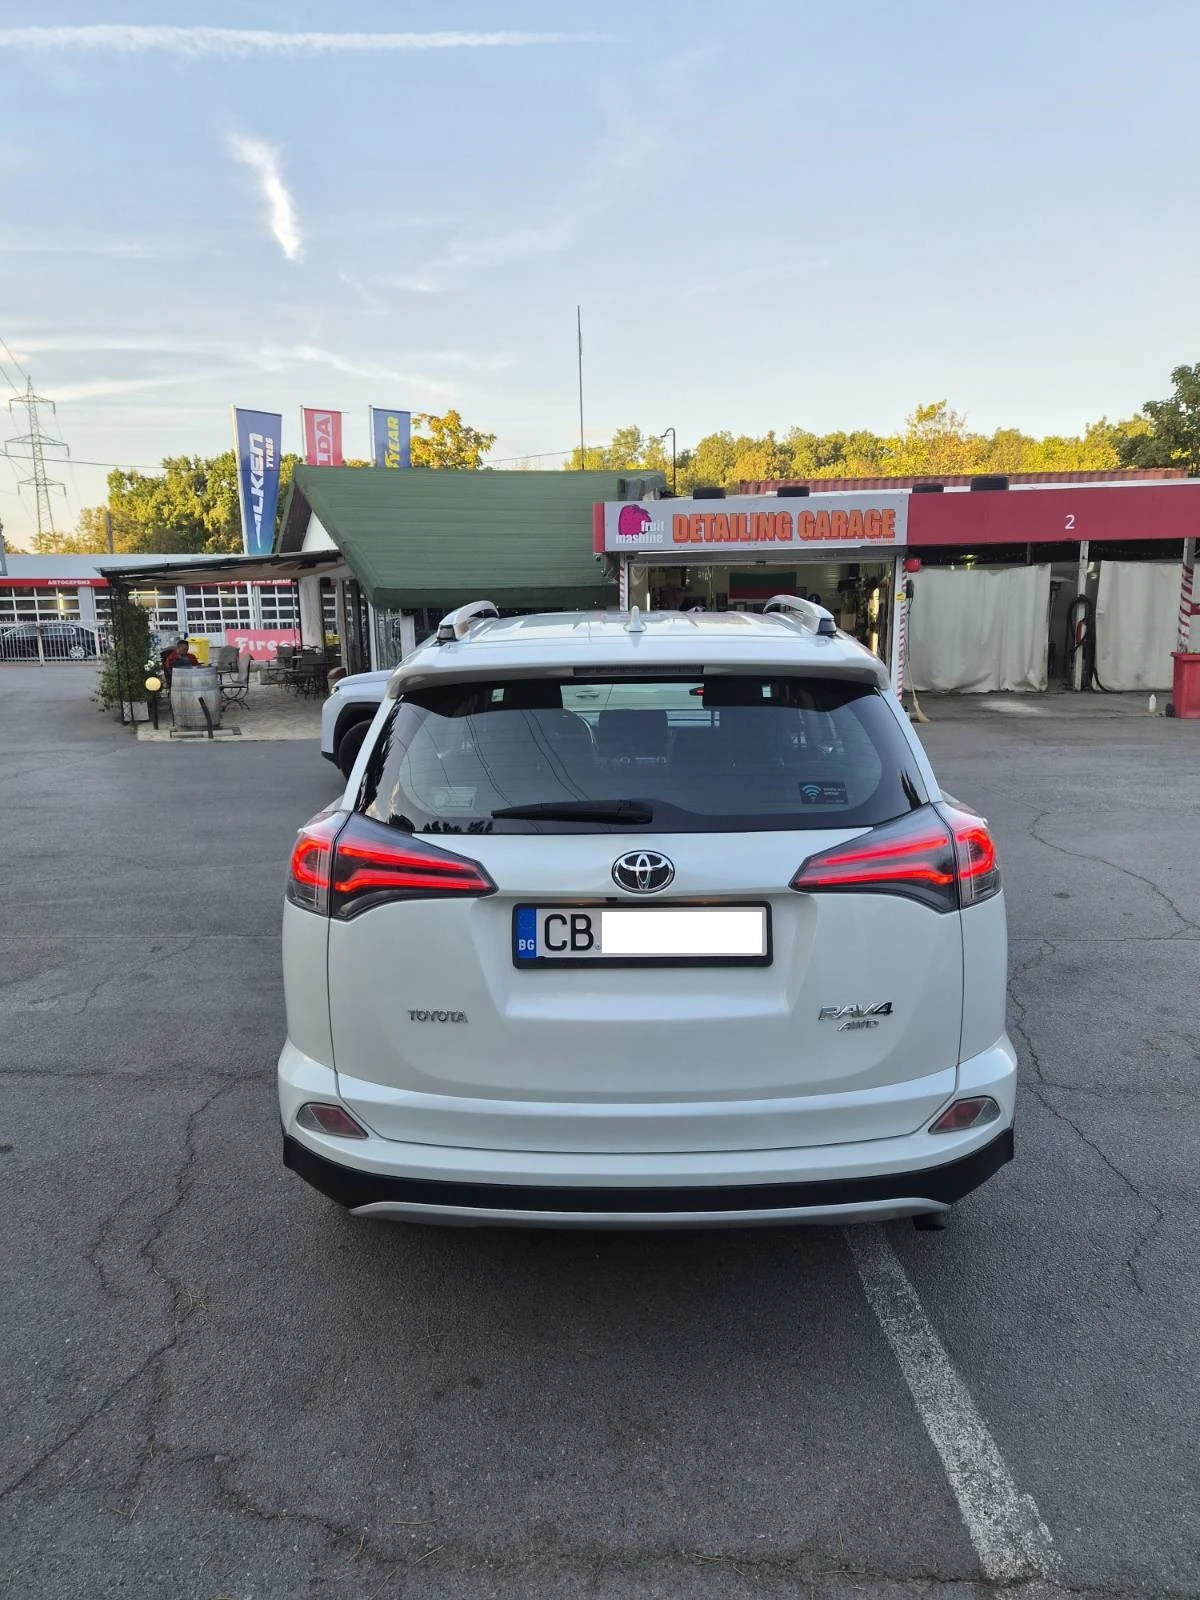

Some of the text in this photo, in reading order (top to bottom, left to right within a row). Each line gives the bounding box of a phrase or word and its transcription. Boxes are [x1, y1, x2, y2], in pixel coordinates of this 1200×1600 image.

[641, 520, 664, 532] fruit
[672, 509, 896, 543] DETAILING GARAGE
[1064, 514, 1075, 530] 2
[544, 913, 594, 951] CB
[518, 939, 535, 950] BG
[408, 1010, 468, 1022] TOYOTA
[818, 1001, 893, 1020] RAV4
